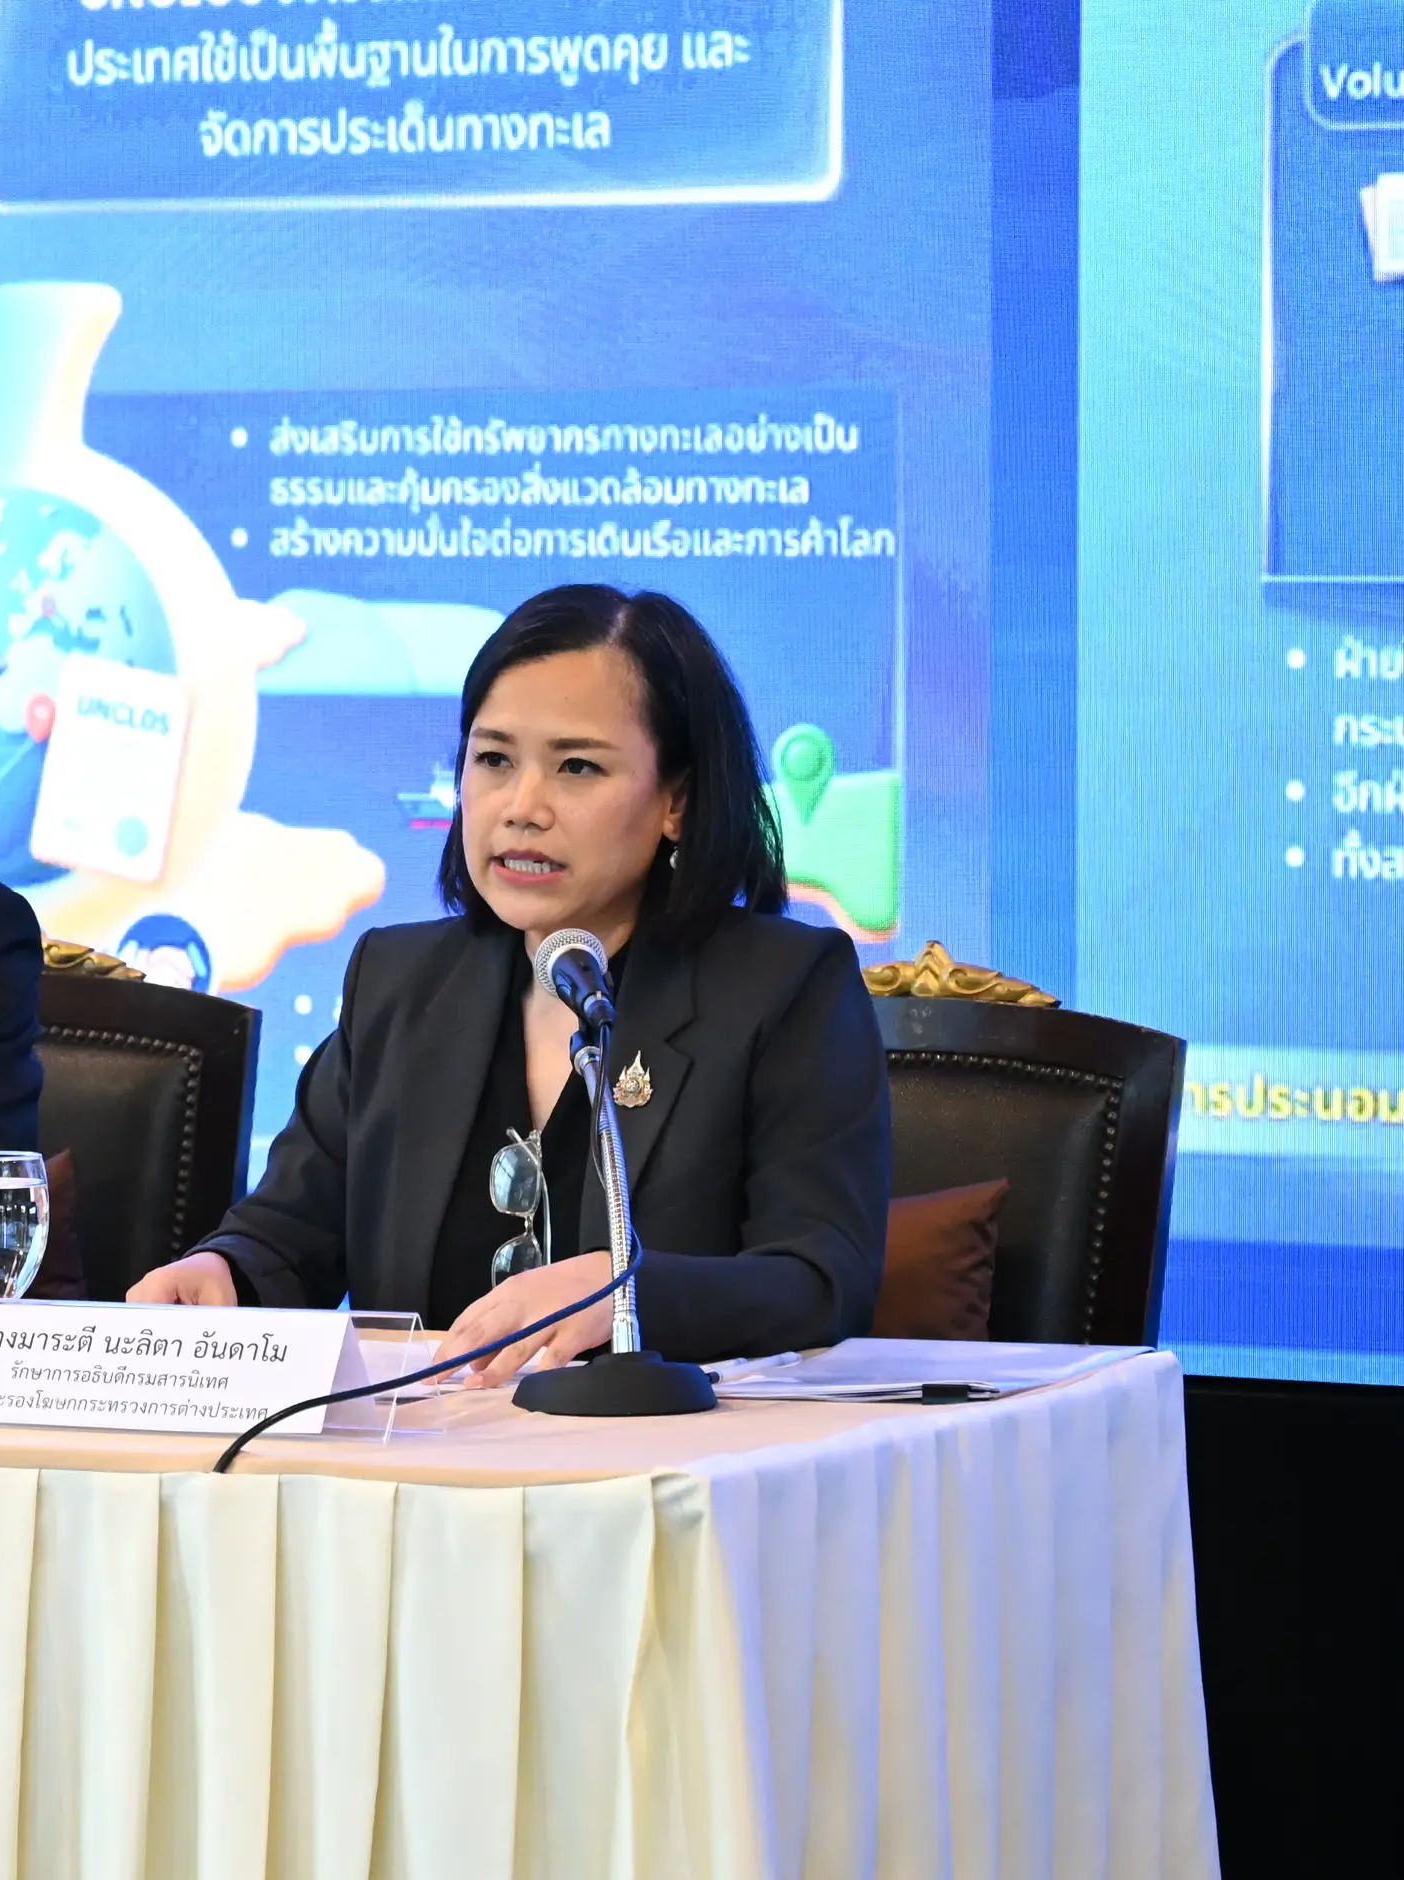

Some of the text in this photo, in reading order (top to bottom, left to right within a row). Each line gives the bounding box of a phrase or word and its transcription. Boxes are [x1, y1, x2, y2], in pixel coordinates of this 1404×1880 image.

[67, 17, 751, 88] ประเทศใช้เป็นพื้นฐานในการพูดคุย และ
[1320, 62, 1404, 99] Volu
[199, 100, 612, 158] จัดการประเด็นทางทะเล
[104, 1328, 183, 1357] นะลิตา
[193, 1330, 288, 1363] อันดาโม
[10, 1359, 229, 1390] รักษาการอธิบดีกรมสารนิเทศ
